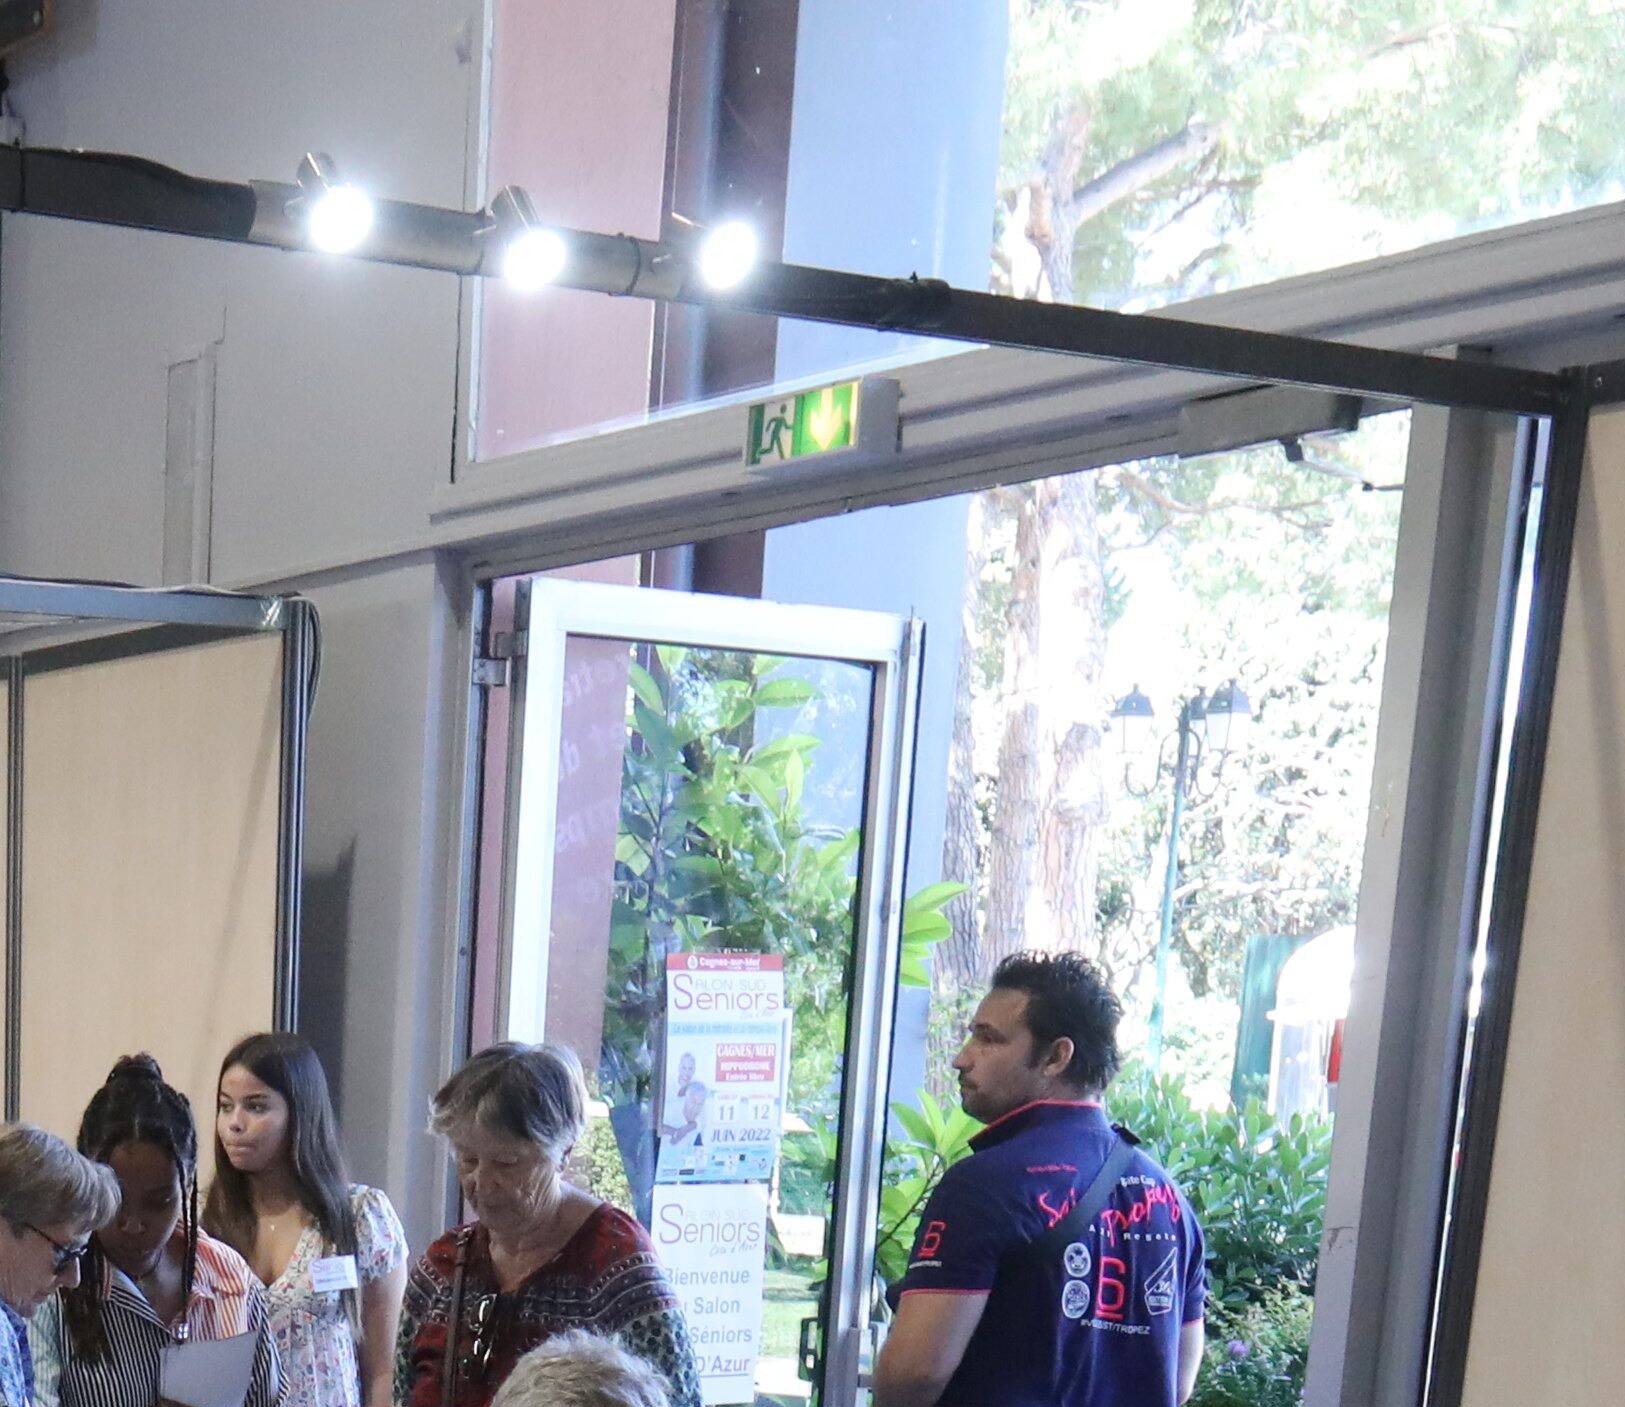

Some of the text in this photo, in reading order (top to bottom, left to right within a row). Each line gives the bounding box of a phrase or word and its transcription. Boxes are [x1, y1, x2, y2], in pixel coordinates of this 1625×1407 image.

[672, 973, 780, 1011] Seniors
[716, 1043, 776, 1059] CAGNES/MER
[718, 1104, 770, 1121] 11 12
[710, 1127, 772, 1143] JUIN 2022
[658, 1203, 761, 1245] Seniors
[693, 1296, 741, 1314] Salon
[690, 1325, 753, 1344] Séniors
